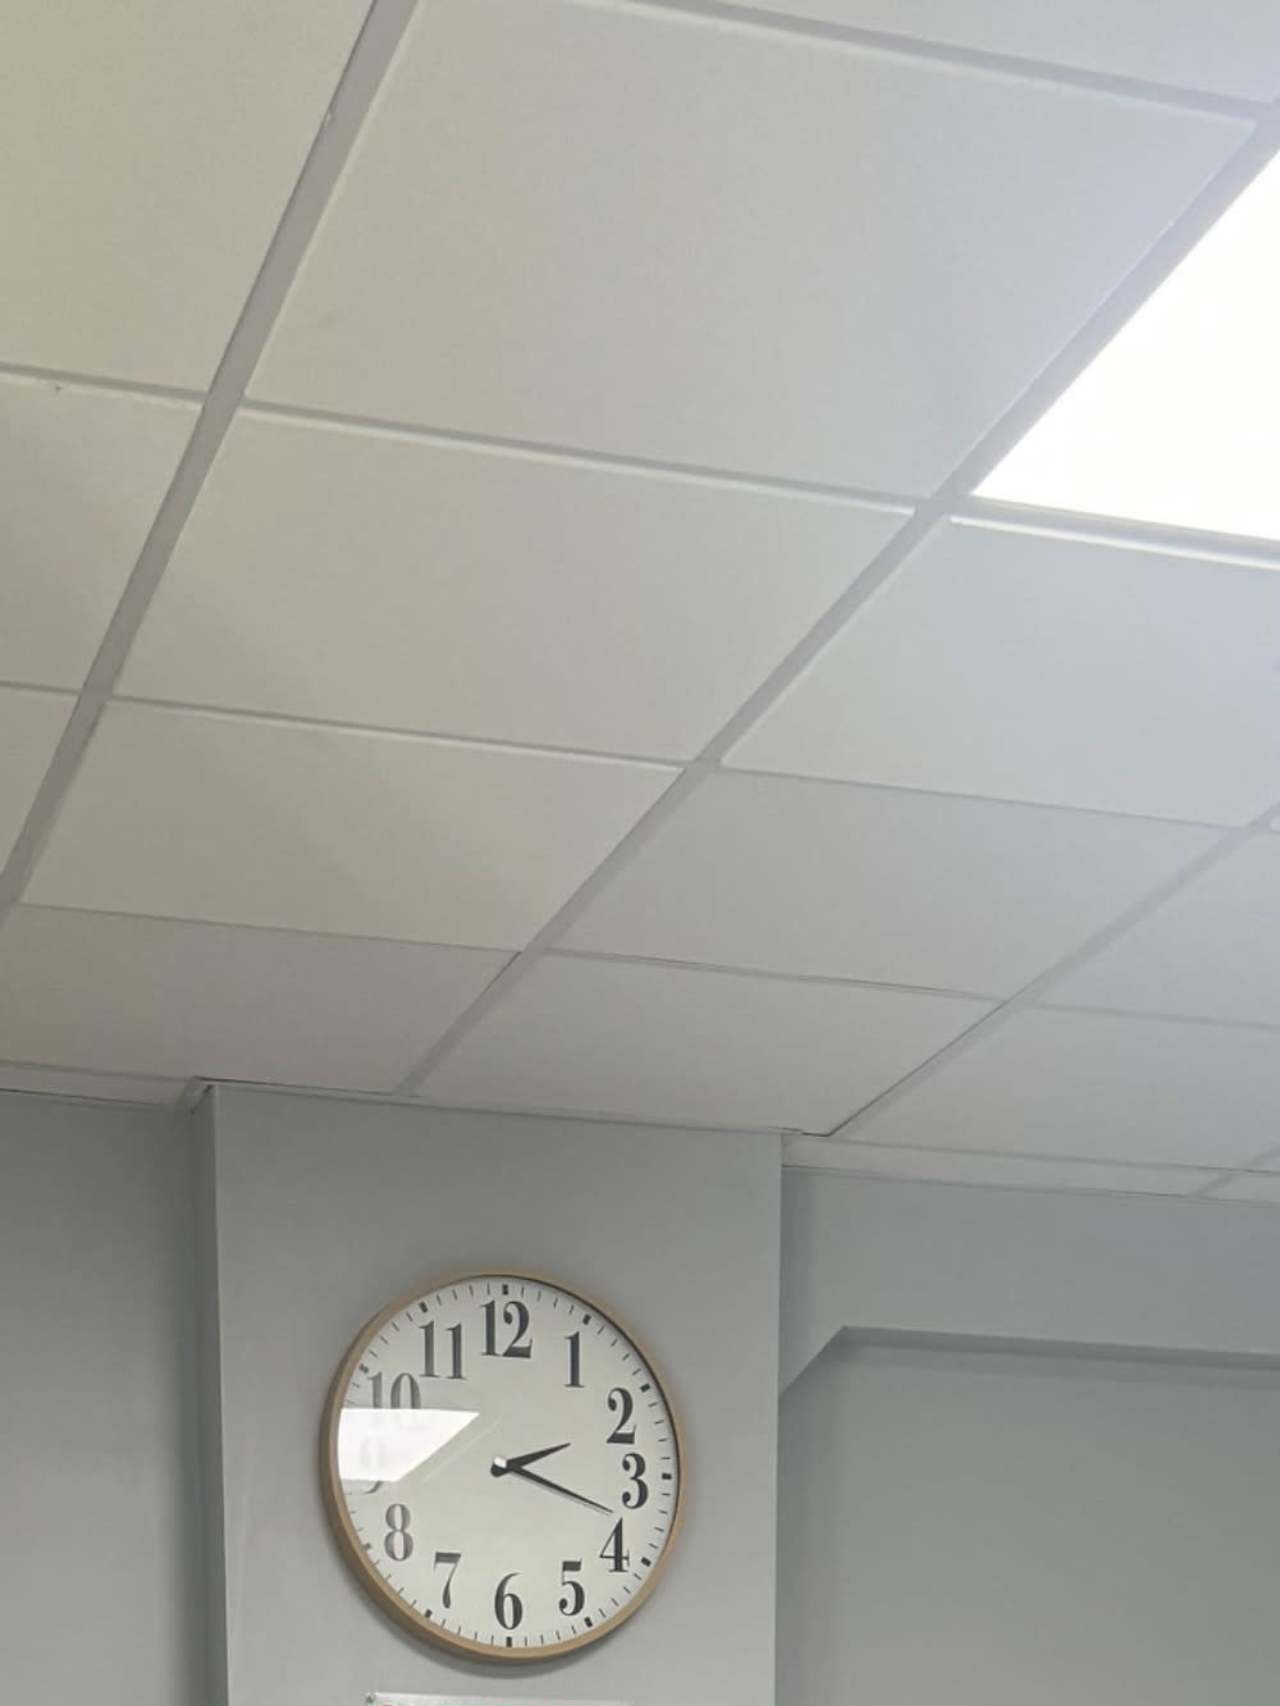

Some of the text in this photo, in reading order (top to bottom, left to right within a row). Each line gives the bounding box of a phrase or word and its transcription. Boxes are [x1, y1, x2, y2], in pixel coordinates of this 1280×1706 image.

[419, 1321, 467, 1380] 11
[480, 1300, 533, 1359] 12
[564, 1331, 585, 1388] 1
[366, 1370, 422, 1414] 10
[606, 1388, 636, 1444] 2
[622, 1452, 648, 1510] 3
[384, 1503, 414, 1562] 8
[599, 1517, 630, 1573] 4
[433, 1551, 463, 1609] 7
[494, 1572, 523, 1631] 6
[559, 1561, 585, 1616] 5
